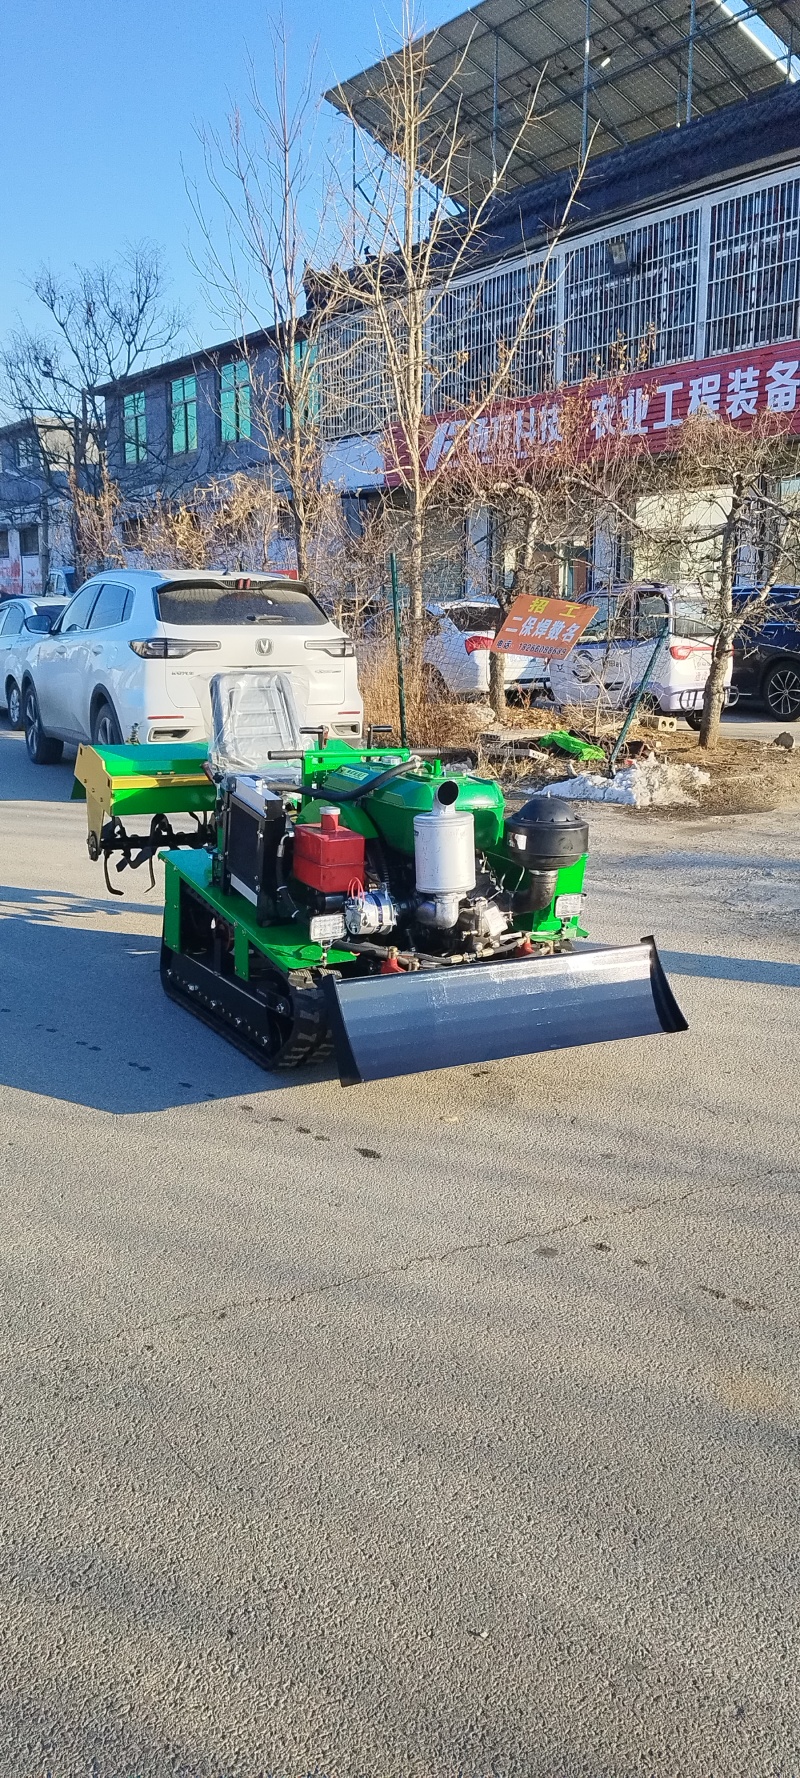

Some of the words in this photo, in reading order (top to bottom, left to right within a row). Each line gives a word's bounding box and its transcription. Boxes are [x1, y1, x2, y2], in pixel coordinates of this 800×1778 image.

[590, 360, 800, 440] 农业工程装备
